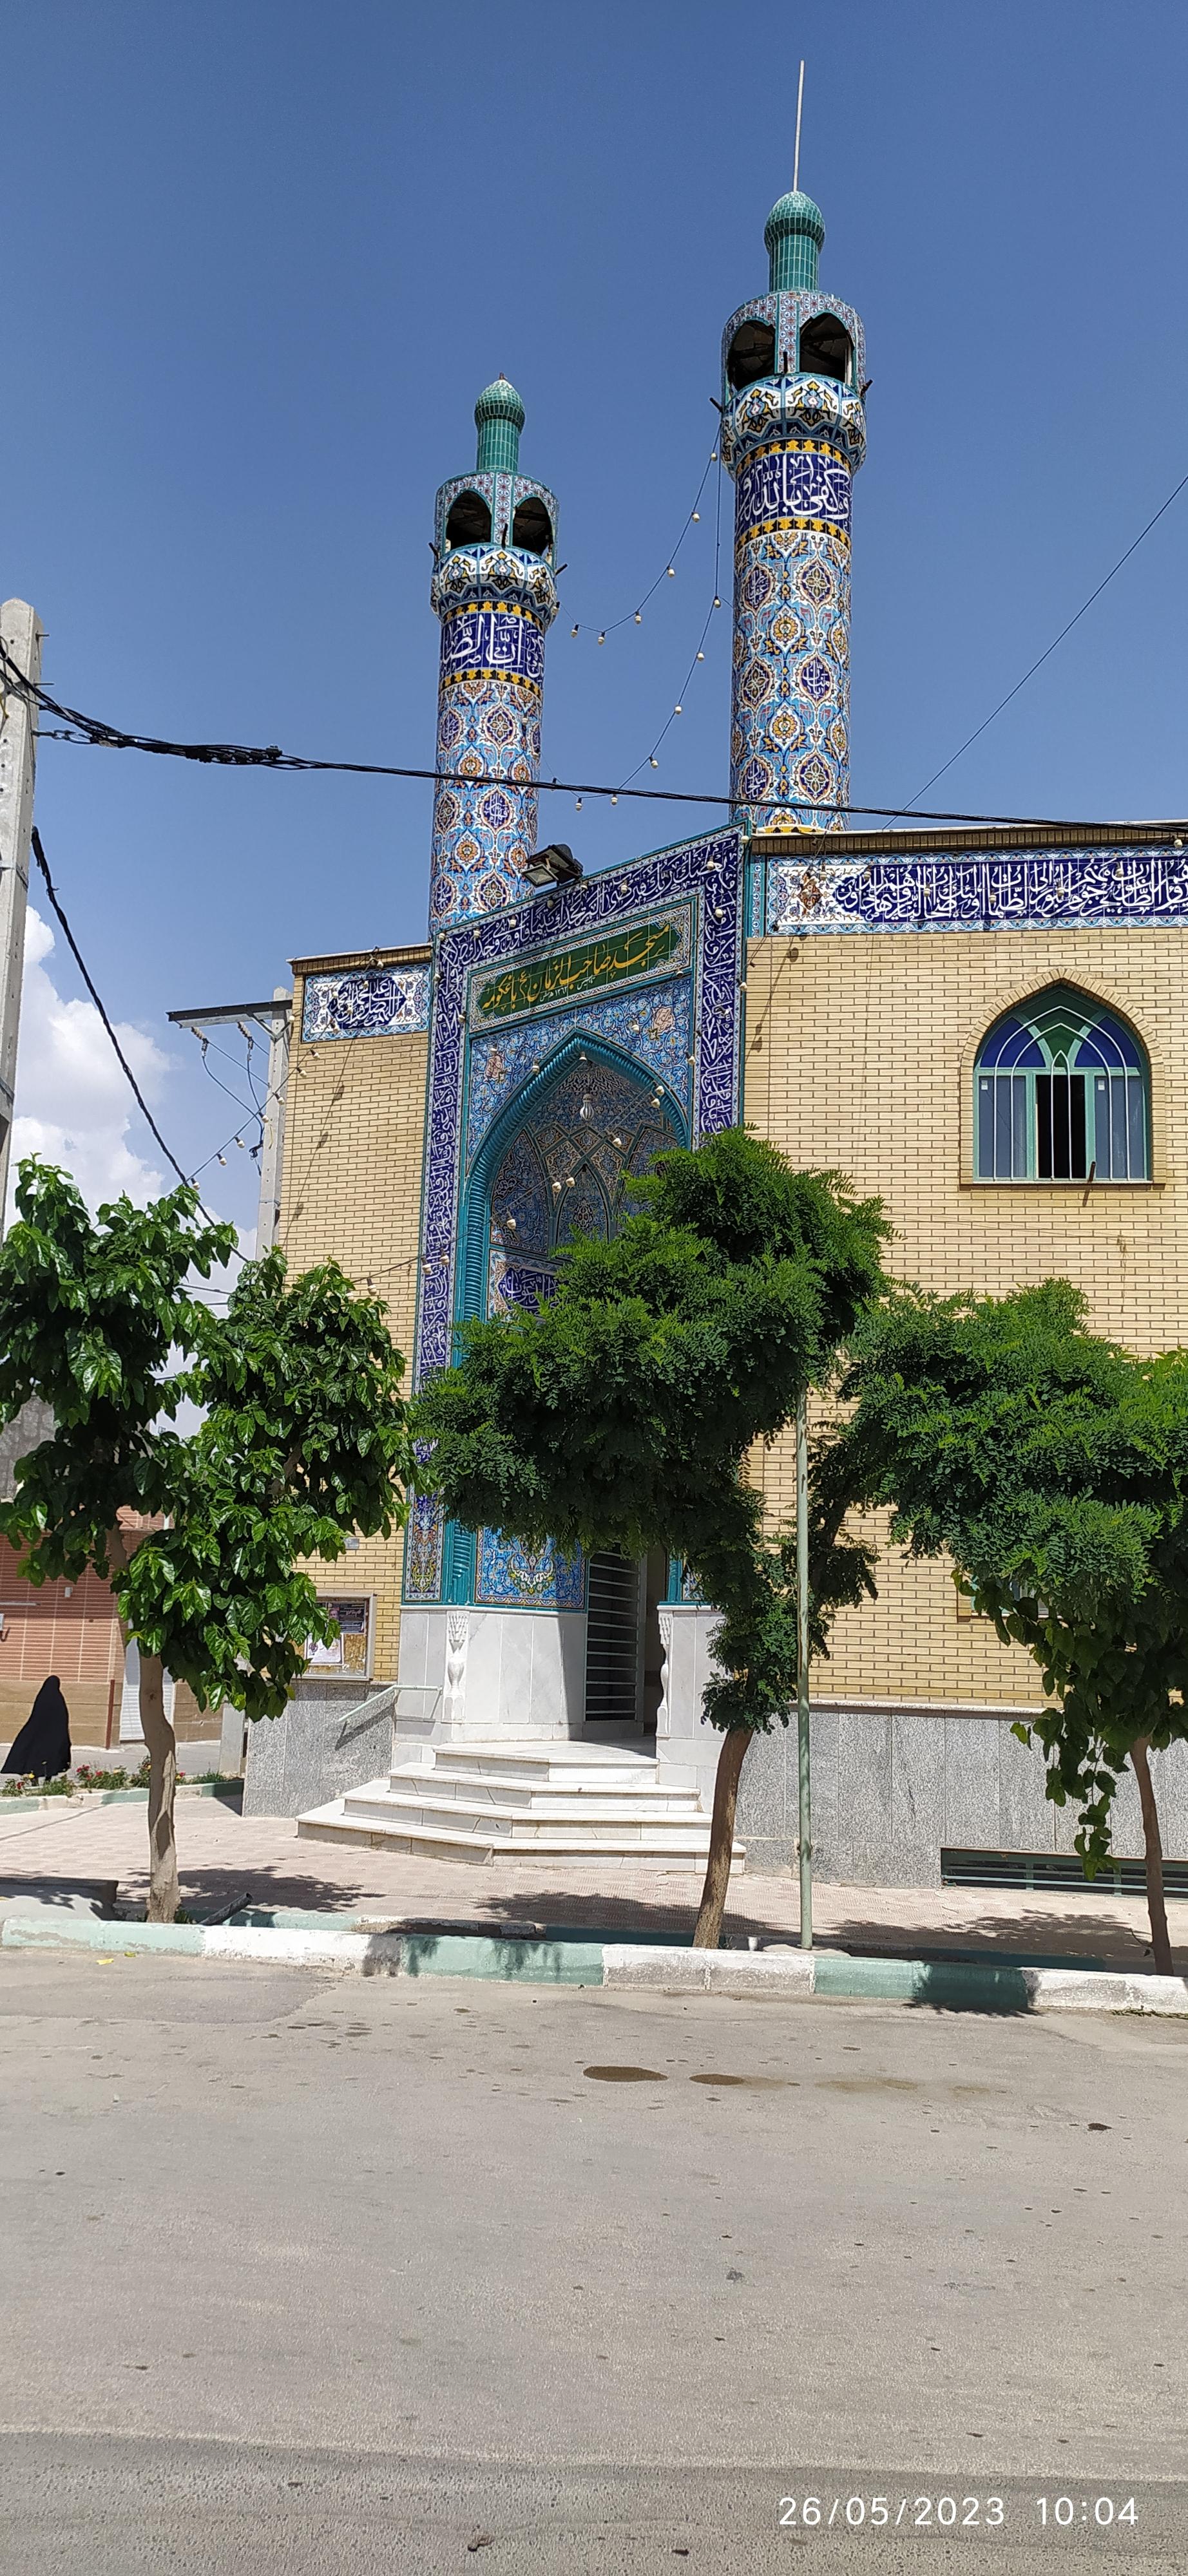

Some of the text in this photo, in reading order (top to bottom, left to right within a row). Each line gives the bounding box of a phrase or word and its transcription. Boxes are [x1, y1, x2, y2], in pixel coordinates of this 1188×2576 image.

[559, 948, 612, 989] صاحب
[608, 923, 671, 969] مسجد
[529, 954, 573, 1002] الزمان
